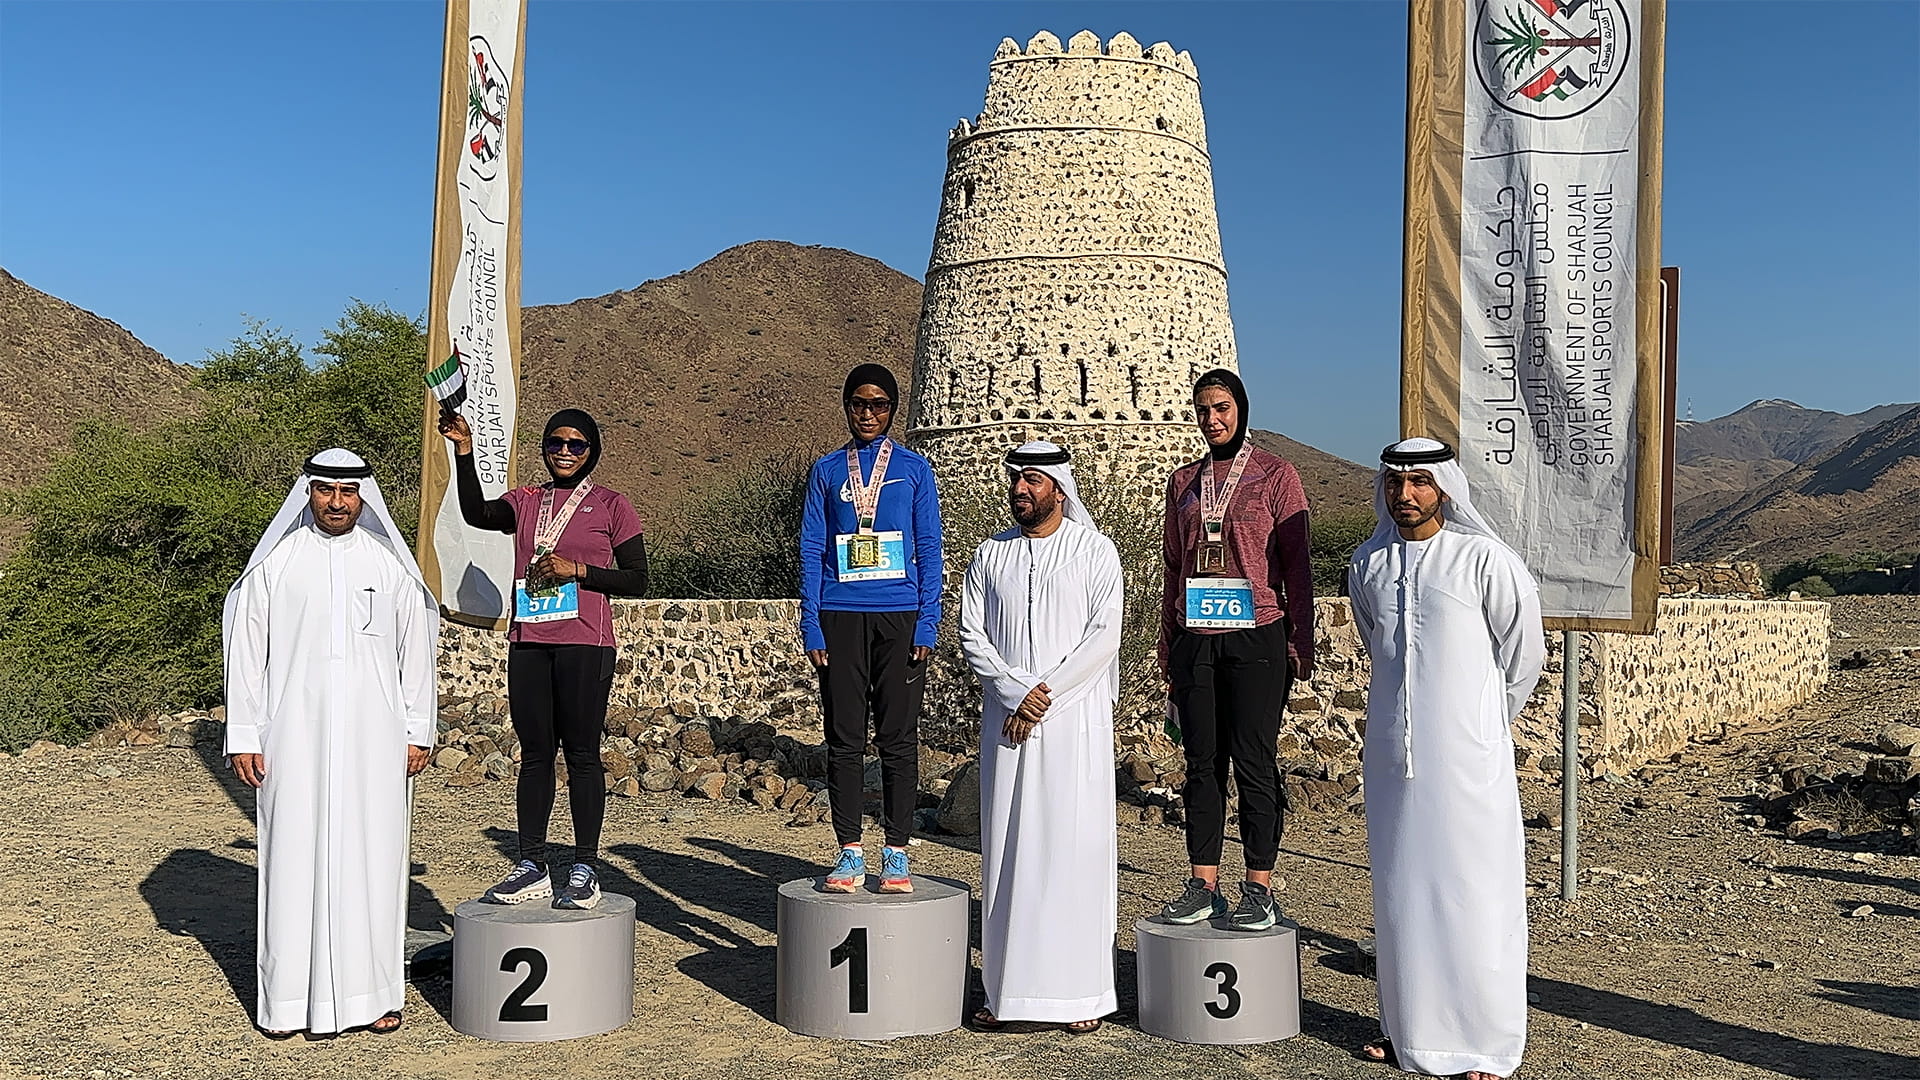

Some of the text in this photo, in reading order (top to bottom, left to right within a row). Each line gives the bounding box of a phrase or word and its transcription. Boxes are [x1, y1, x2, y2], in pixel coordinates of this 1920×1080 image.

[483, 248, 497, 321] COUNCIL
[1483, 186, 1524, 465] حكومة الشارقة
[1524, 183, 1562, 465] مجلس الشارقة الرياضي
[1566, 184, 1588, 465] GOVERNMENT OF SHARJAH
[1592, 183, 1613, 465] SHARJAH SPORTS COUNCIL
[477, 361, 493, 483] GOVERNM
[487, 403, 508, 484] SHARJAH
[529, 592, 565, 612] 577
[1200, 599, 1242, 616] 576
[498, 946, 549, 1022] 2
[829, 927, 868, 1014] 1
[1203, 961, 1242, 1019] 3
